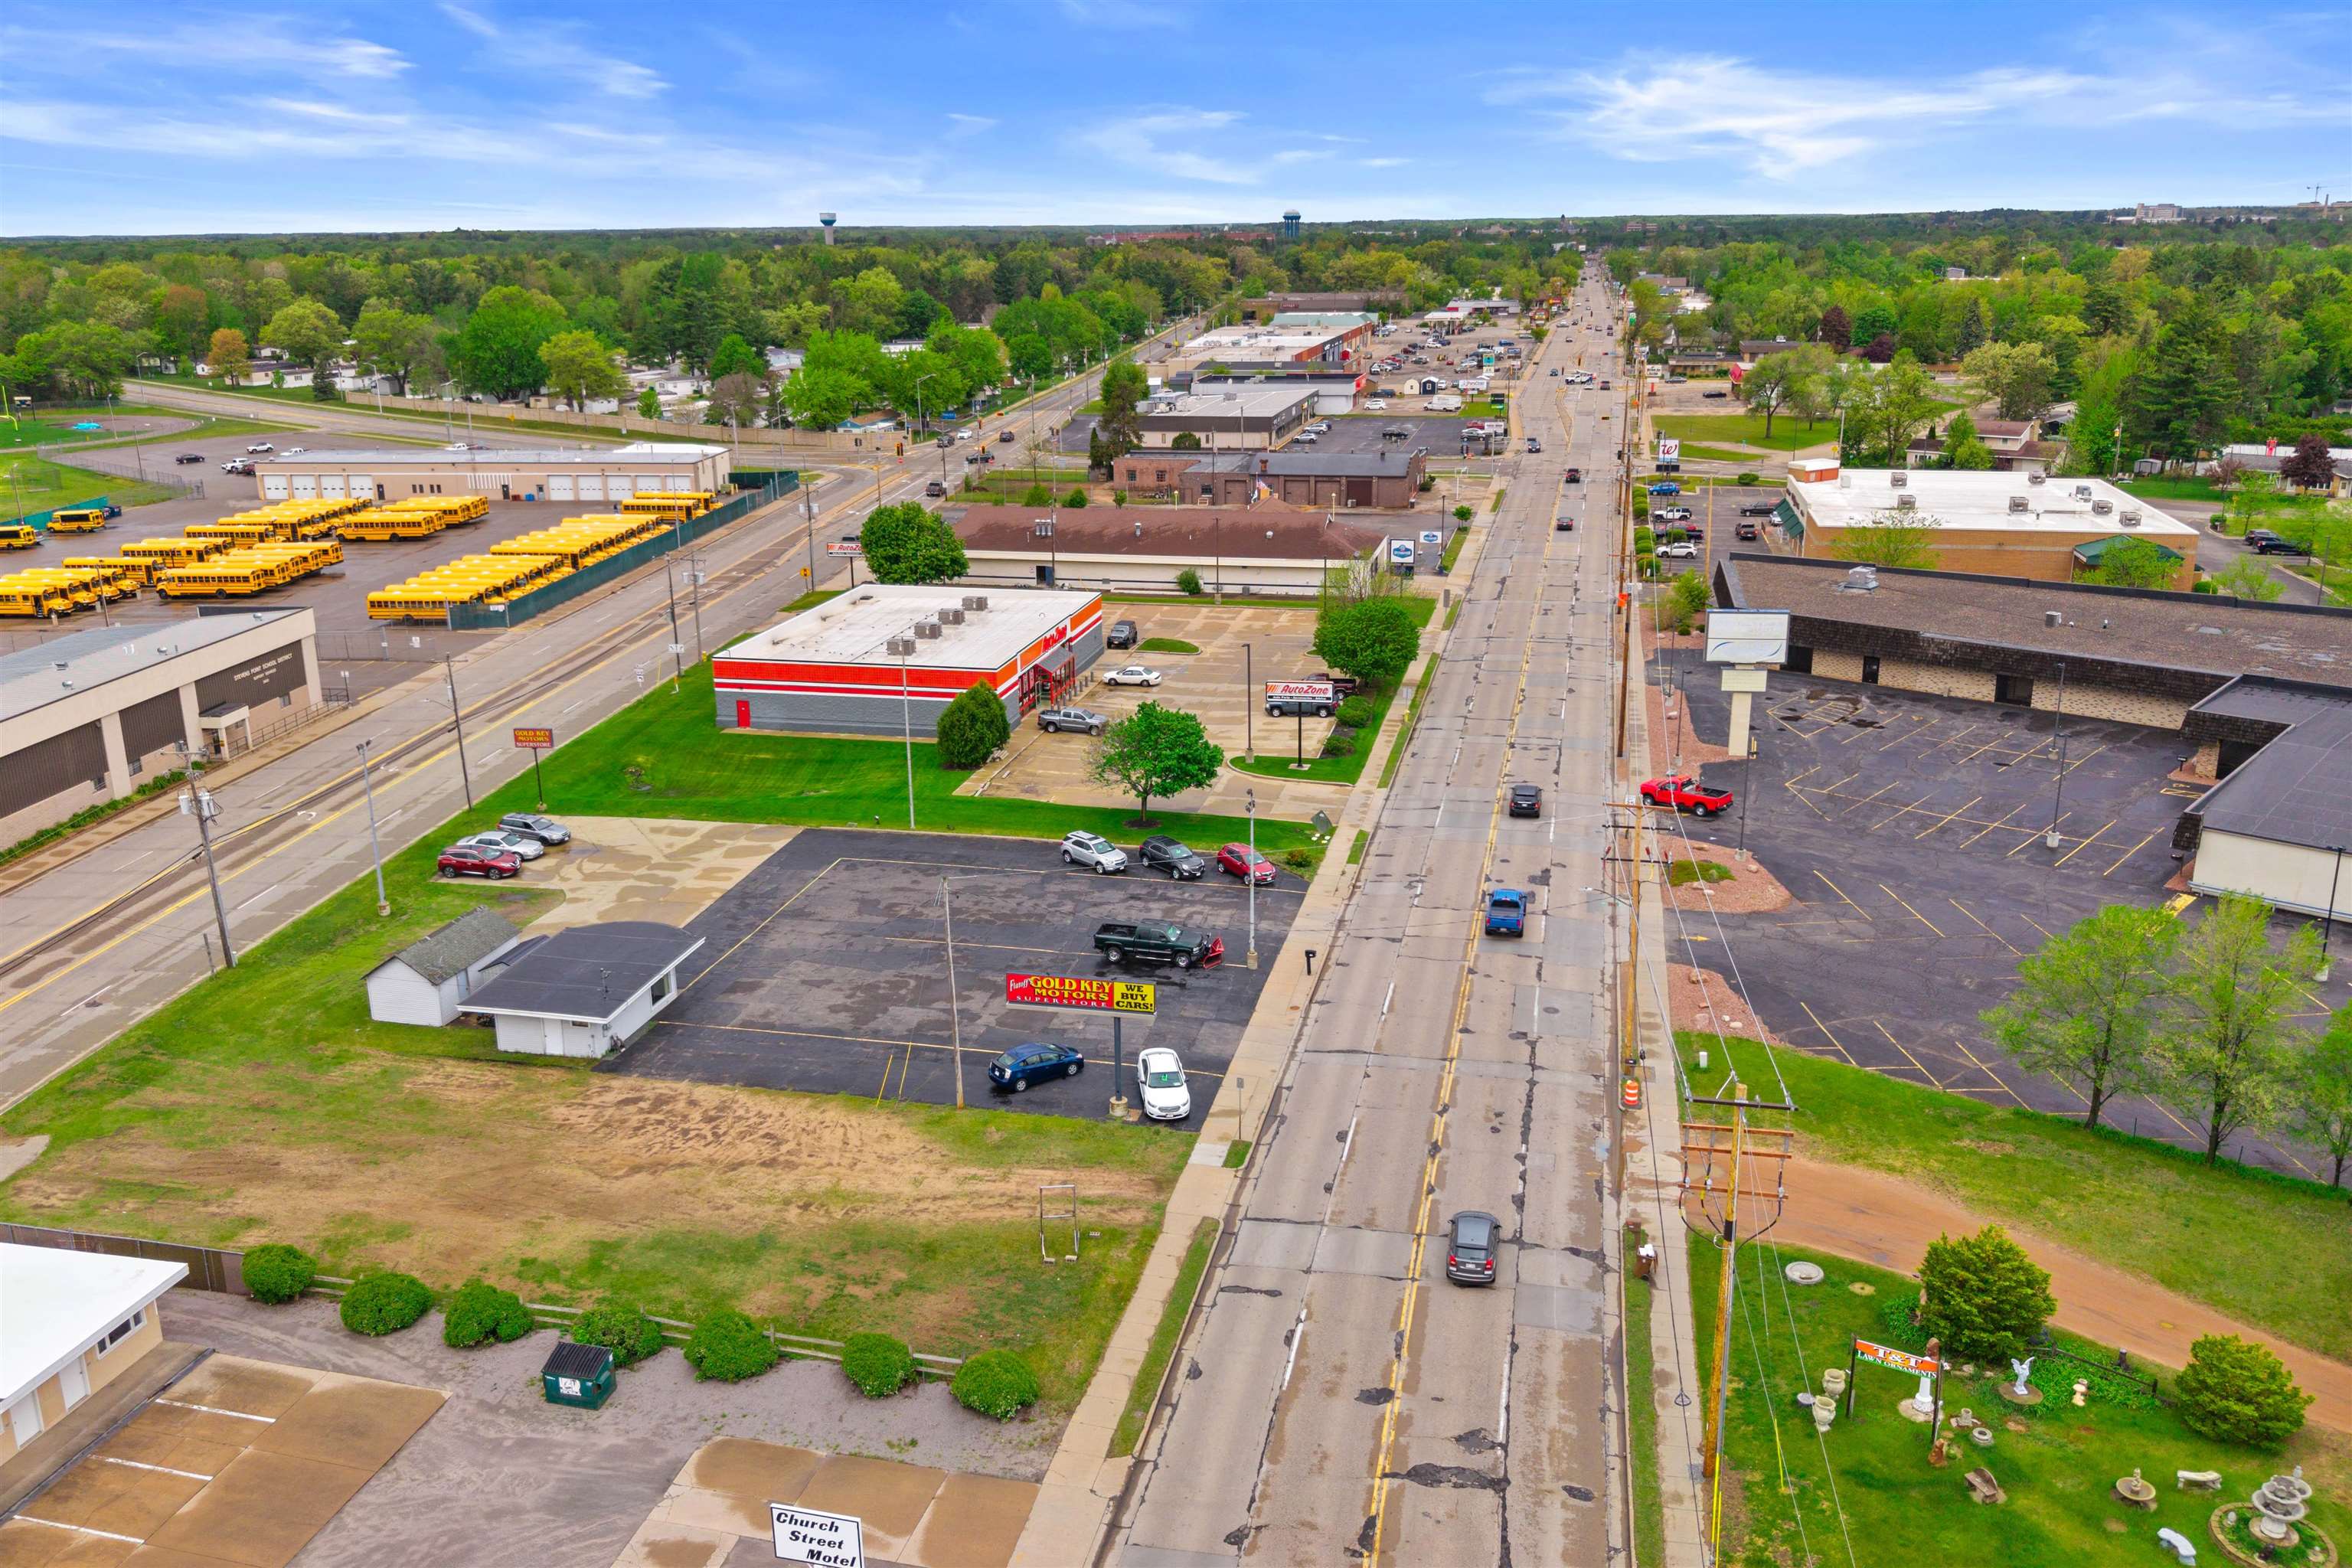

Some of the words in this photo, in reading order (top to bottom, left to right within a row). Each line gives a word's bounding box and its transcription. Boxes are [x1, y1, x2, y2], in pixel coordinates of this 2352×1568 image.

[1281, 684, 1329, 694] AutoZone
[1030, 975, 1080, 991] GOLD
[1080, 979, 1112, 994] KEY
[1125, 984, 1144, 993] WE
[1016, 995, 1108, 1008] SUPERSTORE
[1034, 988, 1109, 1001] MOTORS
[1120, 992, 1148, 1001] BUY
[1115, 1001, 1154, 1011] CARS!
[1857, 1350, 1882, 1364] LAWN
[1883, 1361, 1937, 1379] ORNAMENTS
[1873, 1346, 1922, 1367] T&T
[776, 1511, 840, 1533] Church
[789, 1530, 844, 1550] Street
[806, 1548, 857, 1567] Motel
